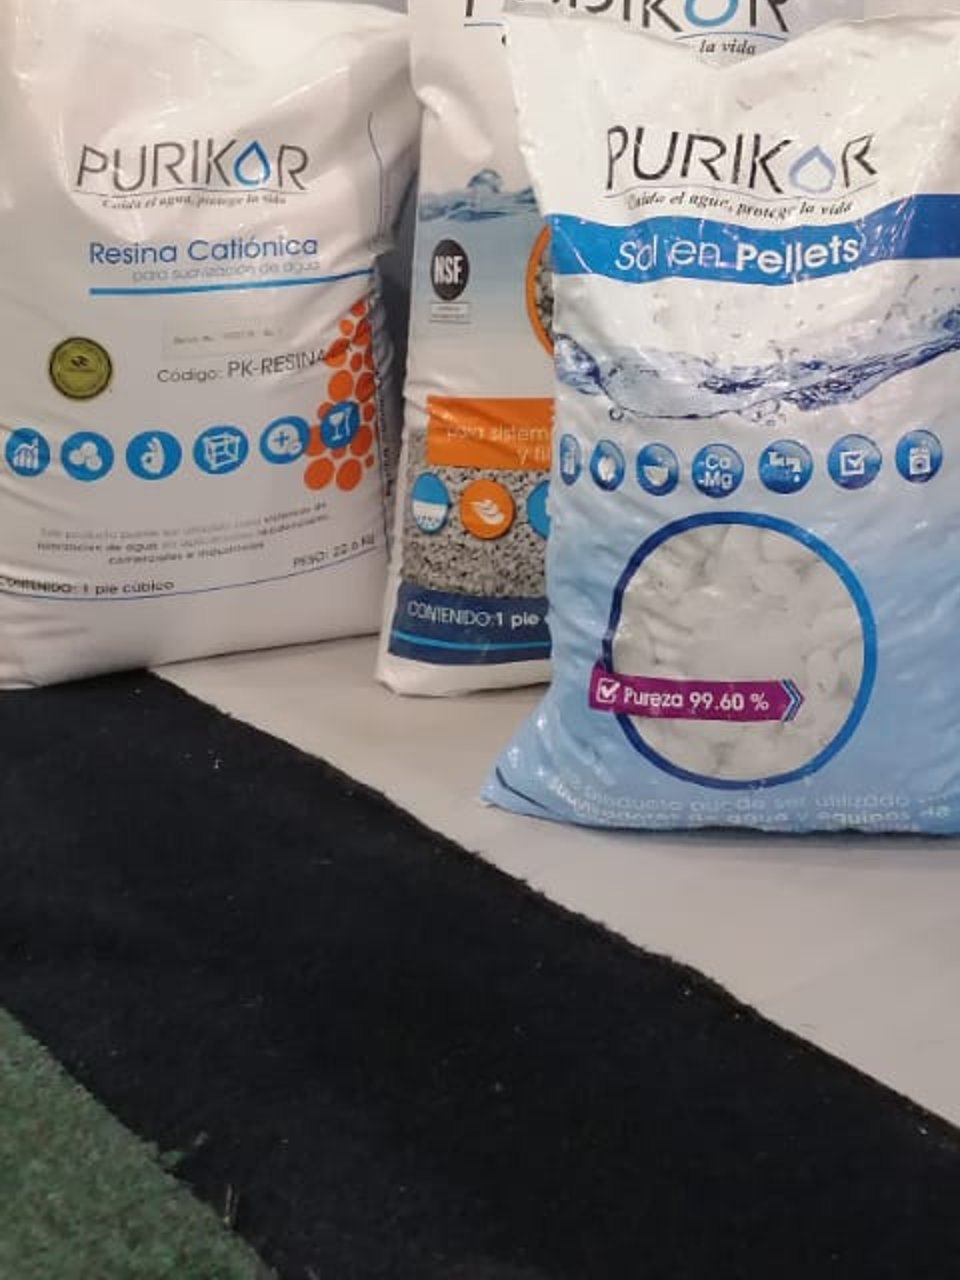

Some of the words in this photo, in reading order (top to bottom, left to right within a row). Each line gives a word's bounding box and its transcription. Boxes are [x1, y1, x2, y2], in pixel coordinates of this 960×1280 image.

[721, 37, 757, 56] vida
[76, 138, 309, 192] PURIKOR
[606, 124, 879, 195] PURIKOR
[89, 240, 178, 265] Resina
[187, 234, 319, 262] Catiónica
[671, 239, 721, 265] en
[736, 234, 861, 274] Pellets
[433, 255, 463, 285] NSF
[95, 581, 119, 596] pie
[510, 610, 540, 630] pie
[623, 686, 684, 708] Pureza
[689, 691, 745, 711] 99.60
[751, 692, 770, 711] %
